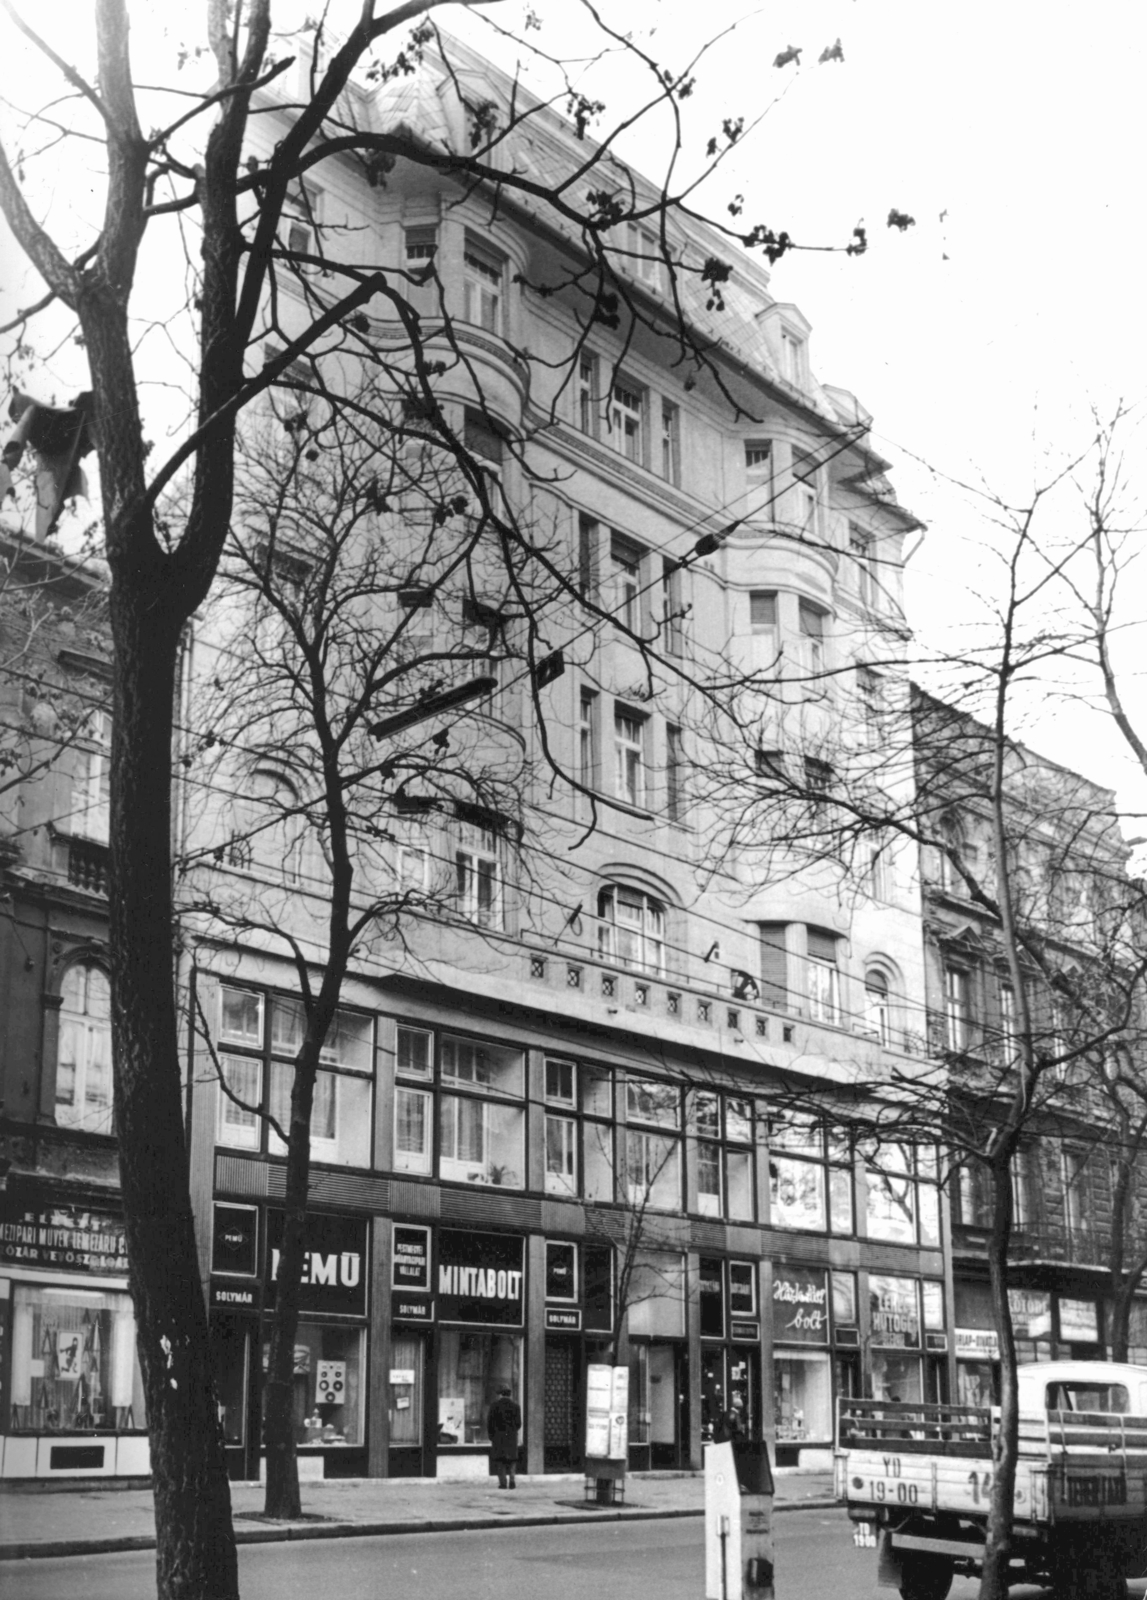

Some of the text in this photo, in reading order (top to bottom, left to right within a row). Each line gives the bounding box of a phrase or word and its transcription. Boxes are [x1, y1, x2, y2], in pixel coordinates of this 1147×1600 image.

[438, 1264, 523, 1301] MINTABOLT
[215, 1291, 253, 1304] SOLYMÁR
[882, 1456, 901, 1478] YD
[869, 1480, 918, 1505] 19-00
